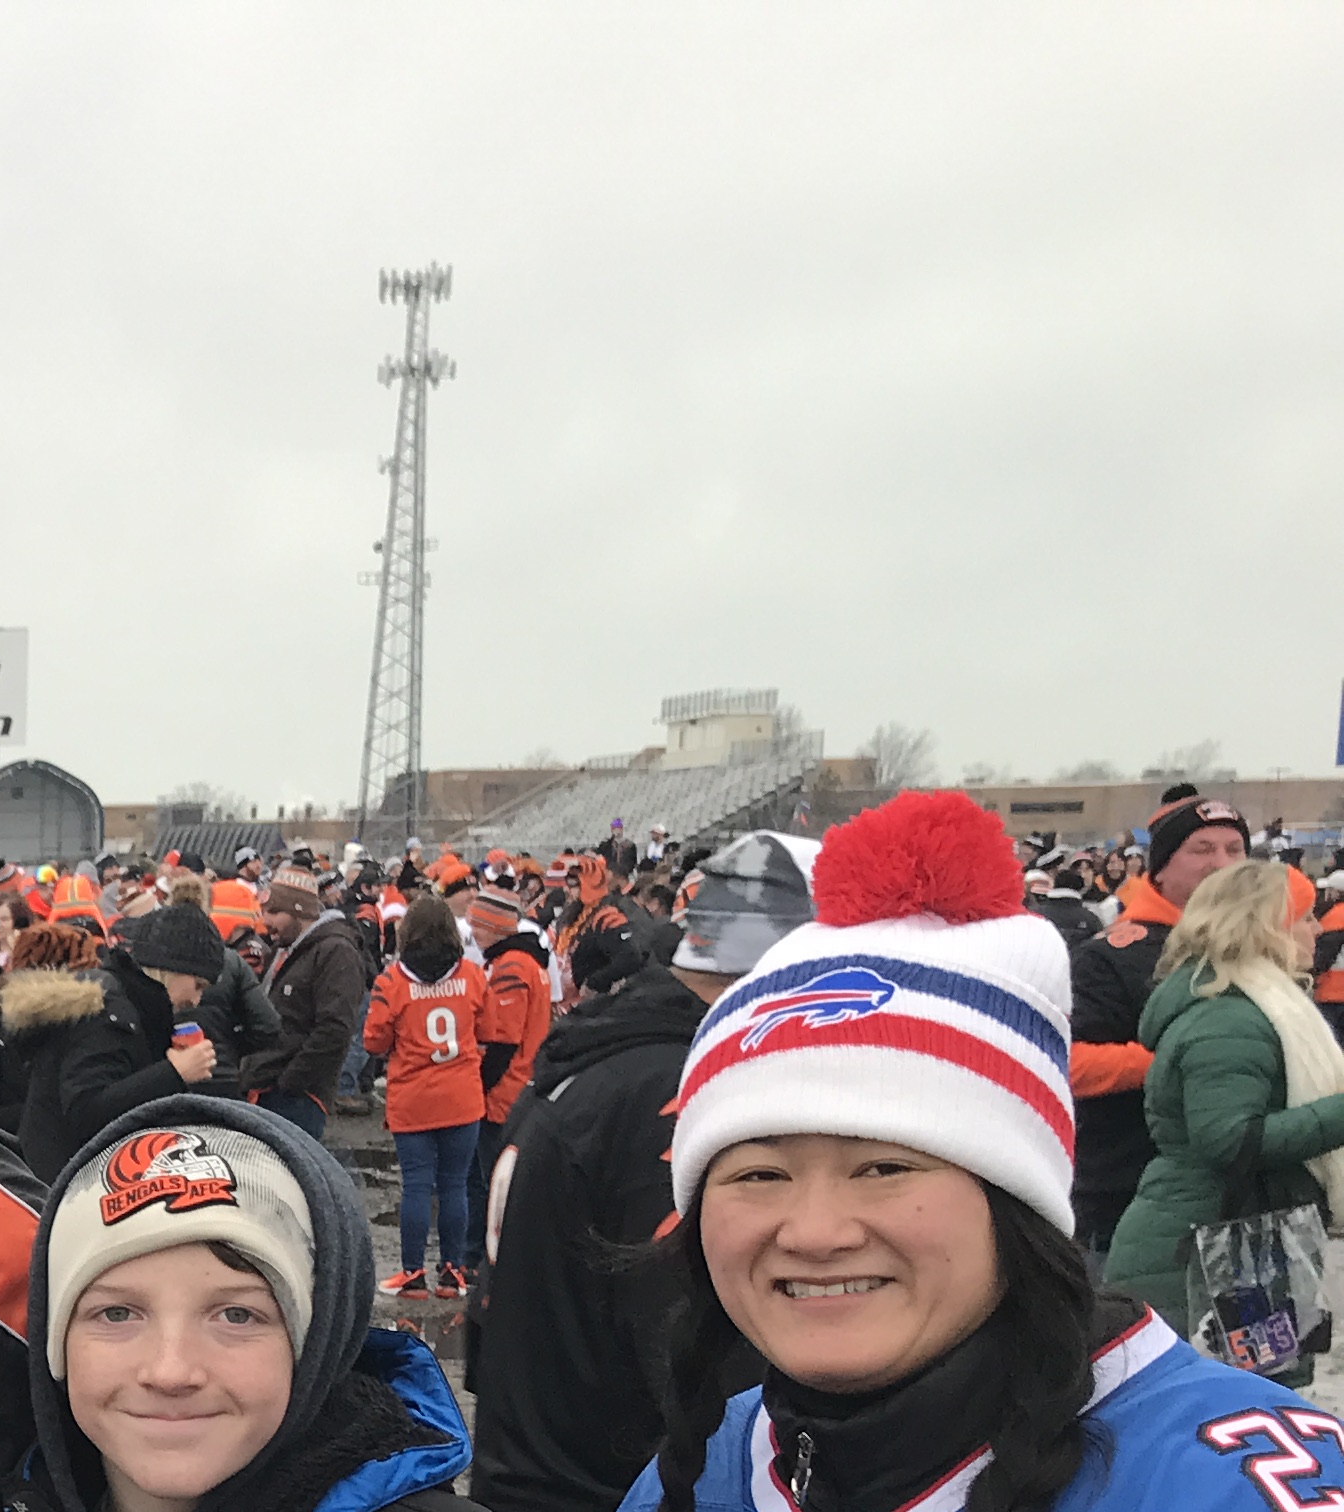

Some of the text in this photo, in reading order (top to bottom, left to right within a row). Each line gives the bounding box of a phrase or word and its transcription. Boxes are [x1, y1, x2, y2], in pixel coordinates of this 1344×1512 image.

[426, 1006, 460, 1064] 9
[105, 1176, 221, 1218] BENGALS AFC
